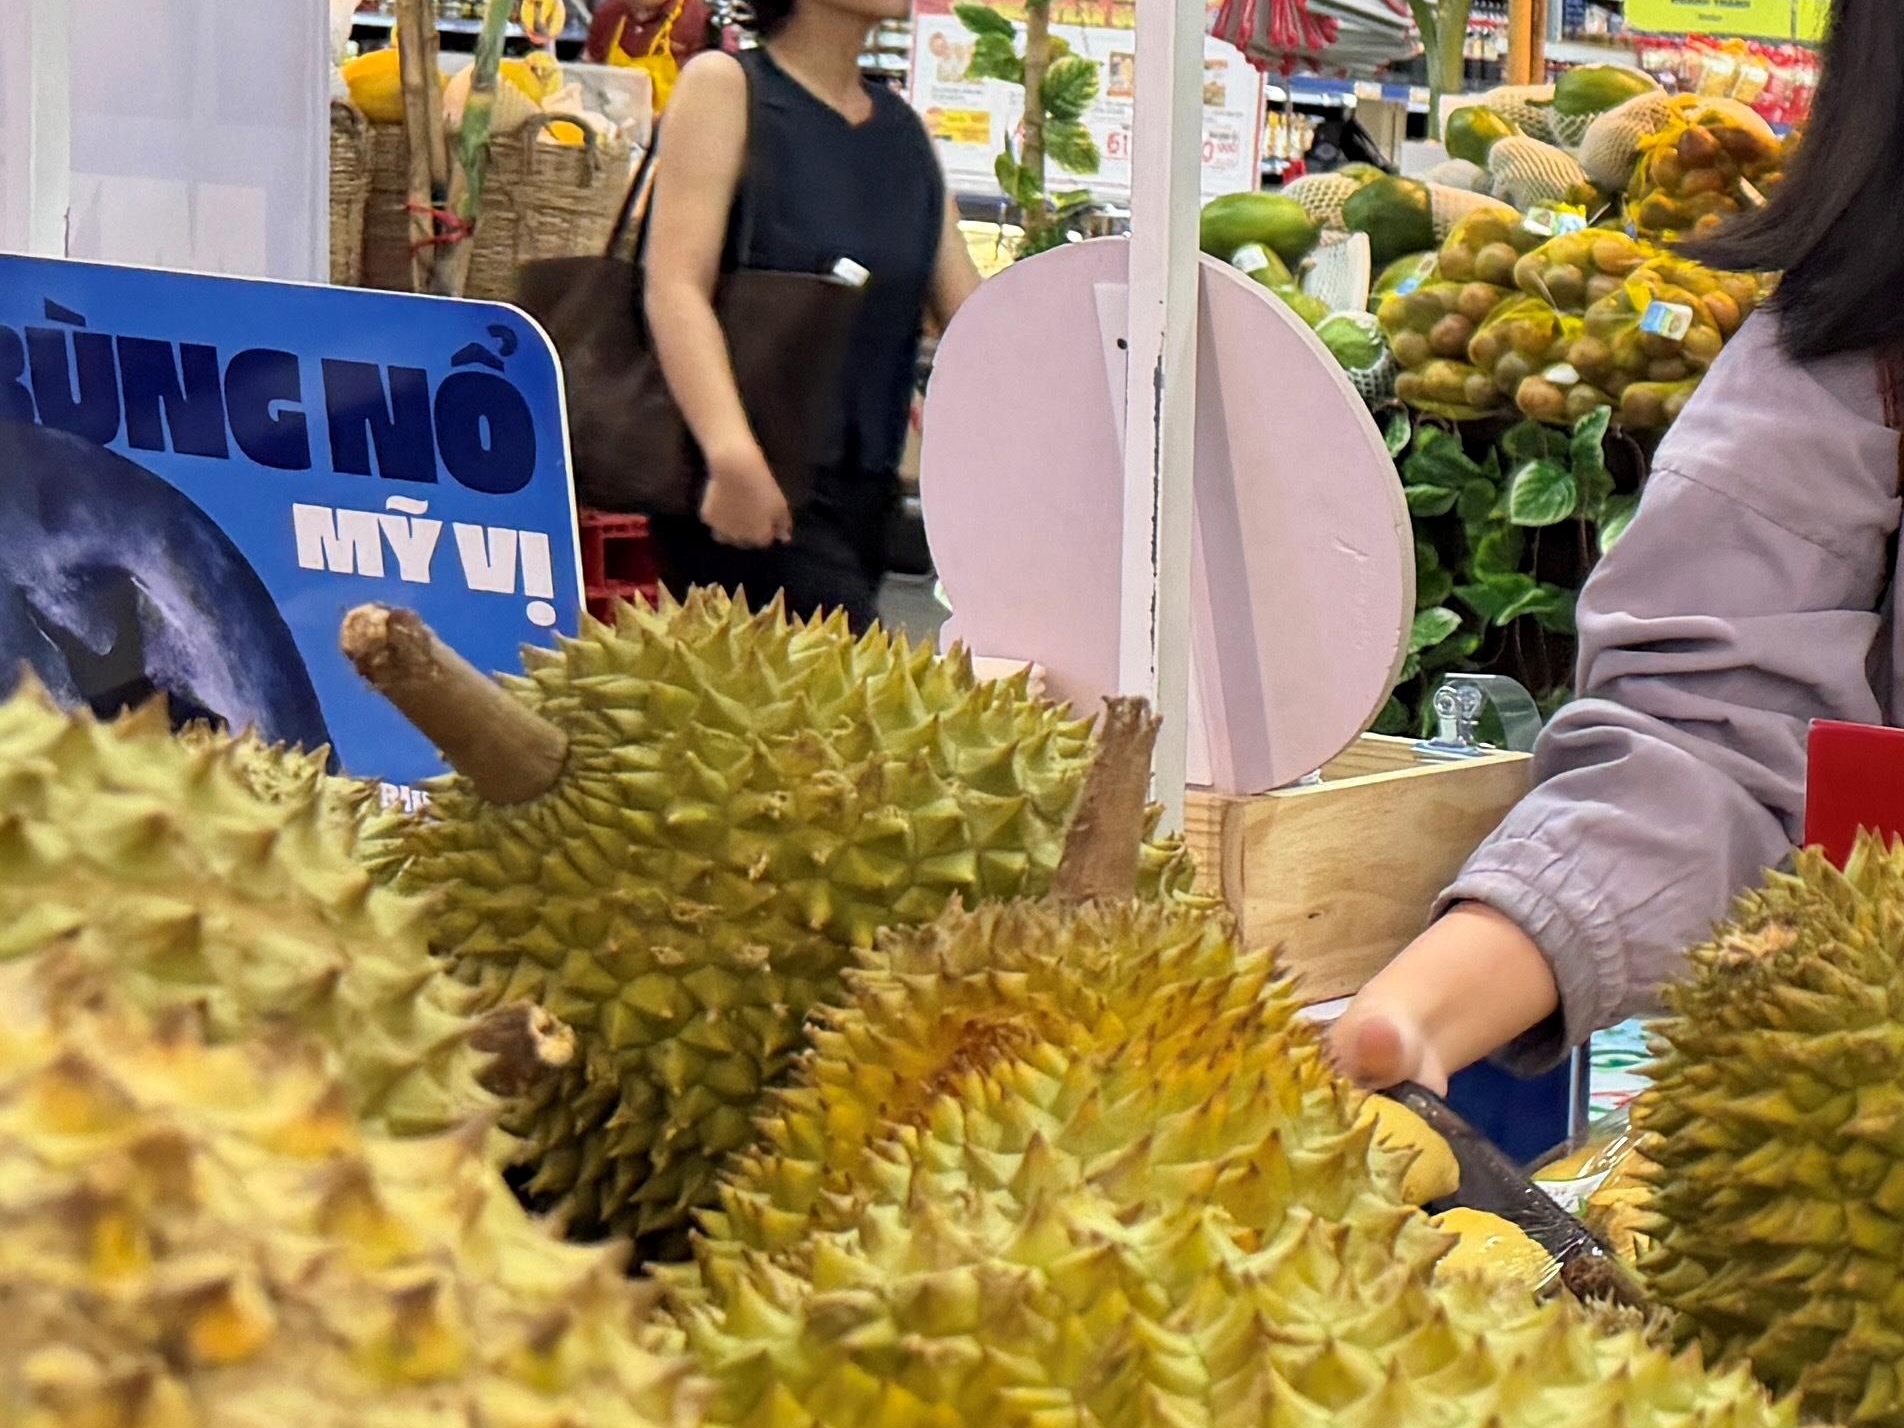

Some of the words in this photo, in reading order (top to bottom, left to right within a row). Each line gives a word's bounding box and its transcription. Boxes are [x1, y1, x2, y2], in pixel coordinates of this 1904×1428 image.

[322, 324, 537, 495] NỔ
[292, 495, 443, 585] MỸ
[452, 521, 557, 628] VỊ
